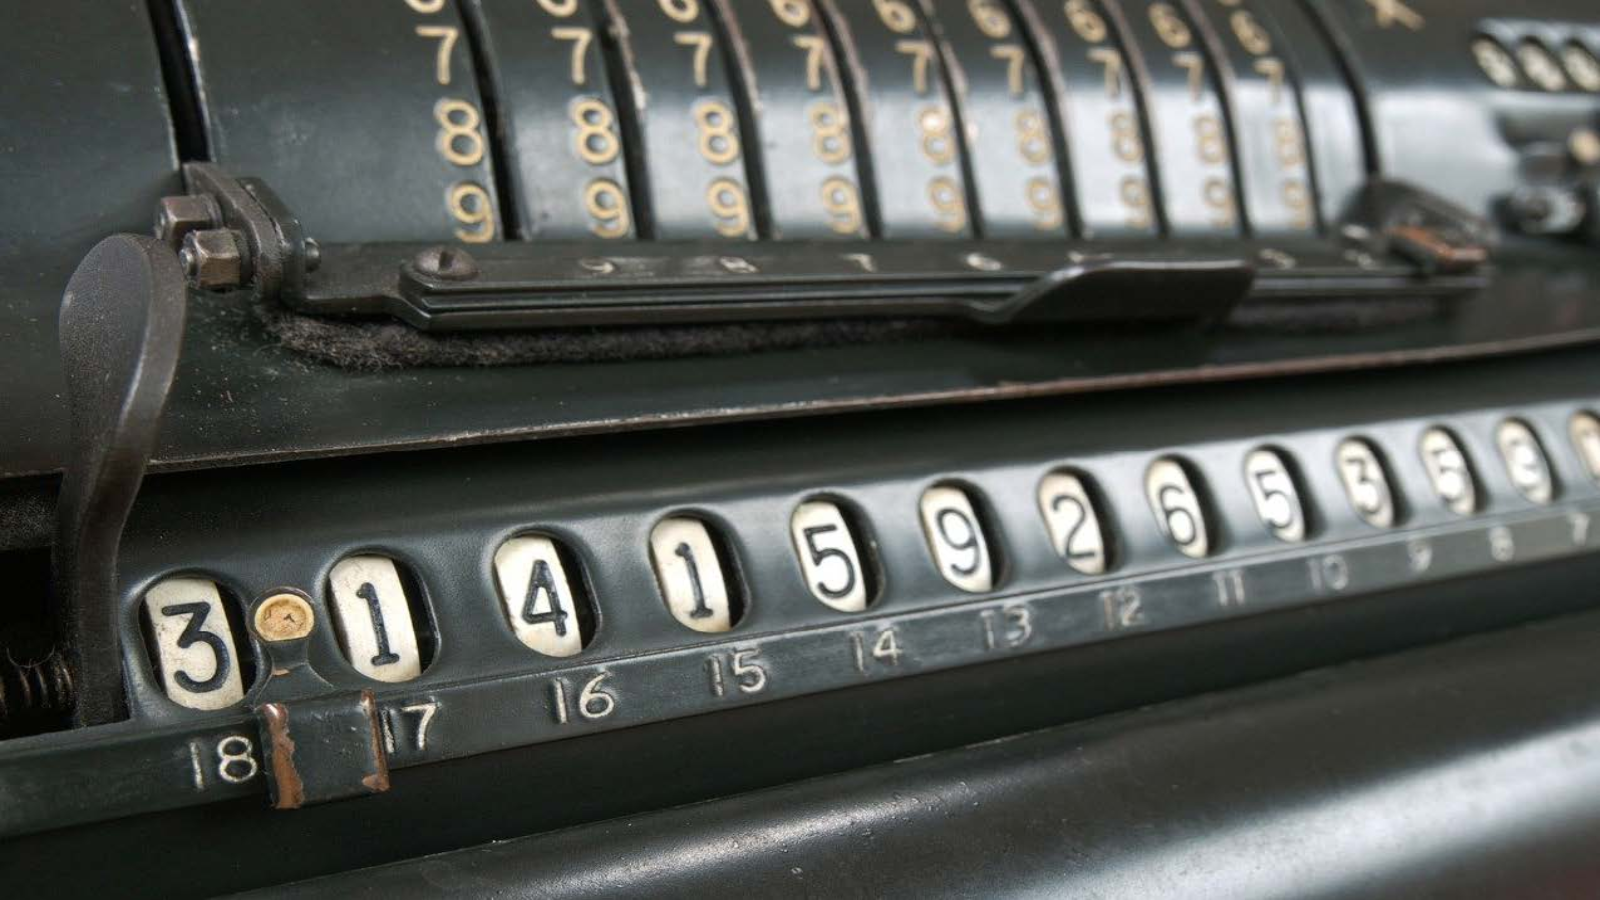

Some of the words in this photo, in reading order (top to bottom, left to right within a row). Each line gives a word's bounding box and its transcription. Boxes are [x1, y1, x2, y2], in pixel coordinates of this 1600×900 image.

[415, 25, 460, 85] 7
[551, 27, 594, 85] 7
[674, 31, 713, 86] 7
[793, 34, 828, 90] 7
[895, 39, 933, 94] 7
[990, 44, 1024, 95] 7
[1087, 46, 1121, 96] 7
[1173, 51, 1203, 100] 7
[1252, 57, 1284, 102] 7
[968, 0, 1011, 38] 6
[1064, 0, 1107, 42] 6
[1149, 2, 1192, 49] 6
[1230, 10, 1271, 55] 6
[435, 98, 485, 166] 8
[571, 95, 619, 165] 8
[694, 100, 739, 165] 8
[809, 102, 851, 164] 8
[917, 105, 956, 166] 8
[1013, 107, 1051, 165] 8
[1109, 109, 1144, 163] 8
[1194, 114, 1228, 164] 8
[448, 180, 494, 243] 9
[584, 177, 629, 238] 9
[706, 176, 749, 237] 9
[821, 176, 860, 235] 9
[928, 175, 965, 233] 9
[1025, 176, 1063, 230] 9
[1120, 176, 1152, 229] 9
[1204, 177, 1235, 229] 9
[162, 601, 230, 693] 3
[356, 582, 400, 666] 1
[522, 559, 568, 637] 4
[675, 542, 714, 619] 1
[803, 523, 855, 598] 5
[935, 508, 981, 576] 9
[1052, 494, 1096, 560] 2
[1159, 485, 1196, 545] 6
[1254, 470, 1293, 529] 5
[1346, 457, 1383, 515] 3
[190, 736, 257, 791] 18
[380, 699, 441, 755] 17
[552, 668, 616, 725] 16
[706, 646, 769, 696] 15
[853, 628, 902, 673] 14
[983, 604, 1033, 650] 13
[1104, 587, 1144, 631] 12
[1213, 568, 1245, 606] 11
[1307, 554, 1348, 591] 10
[1408, 537, 1432, 572] 9
